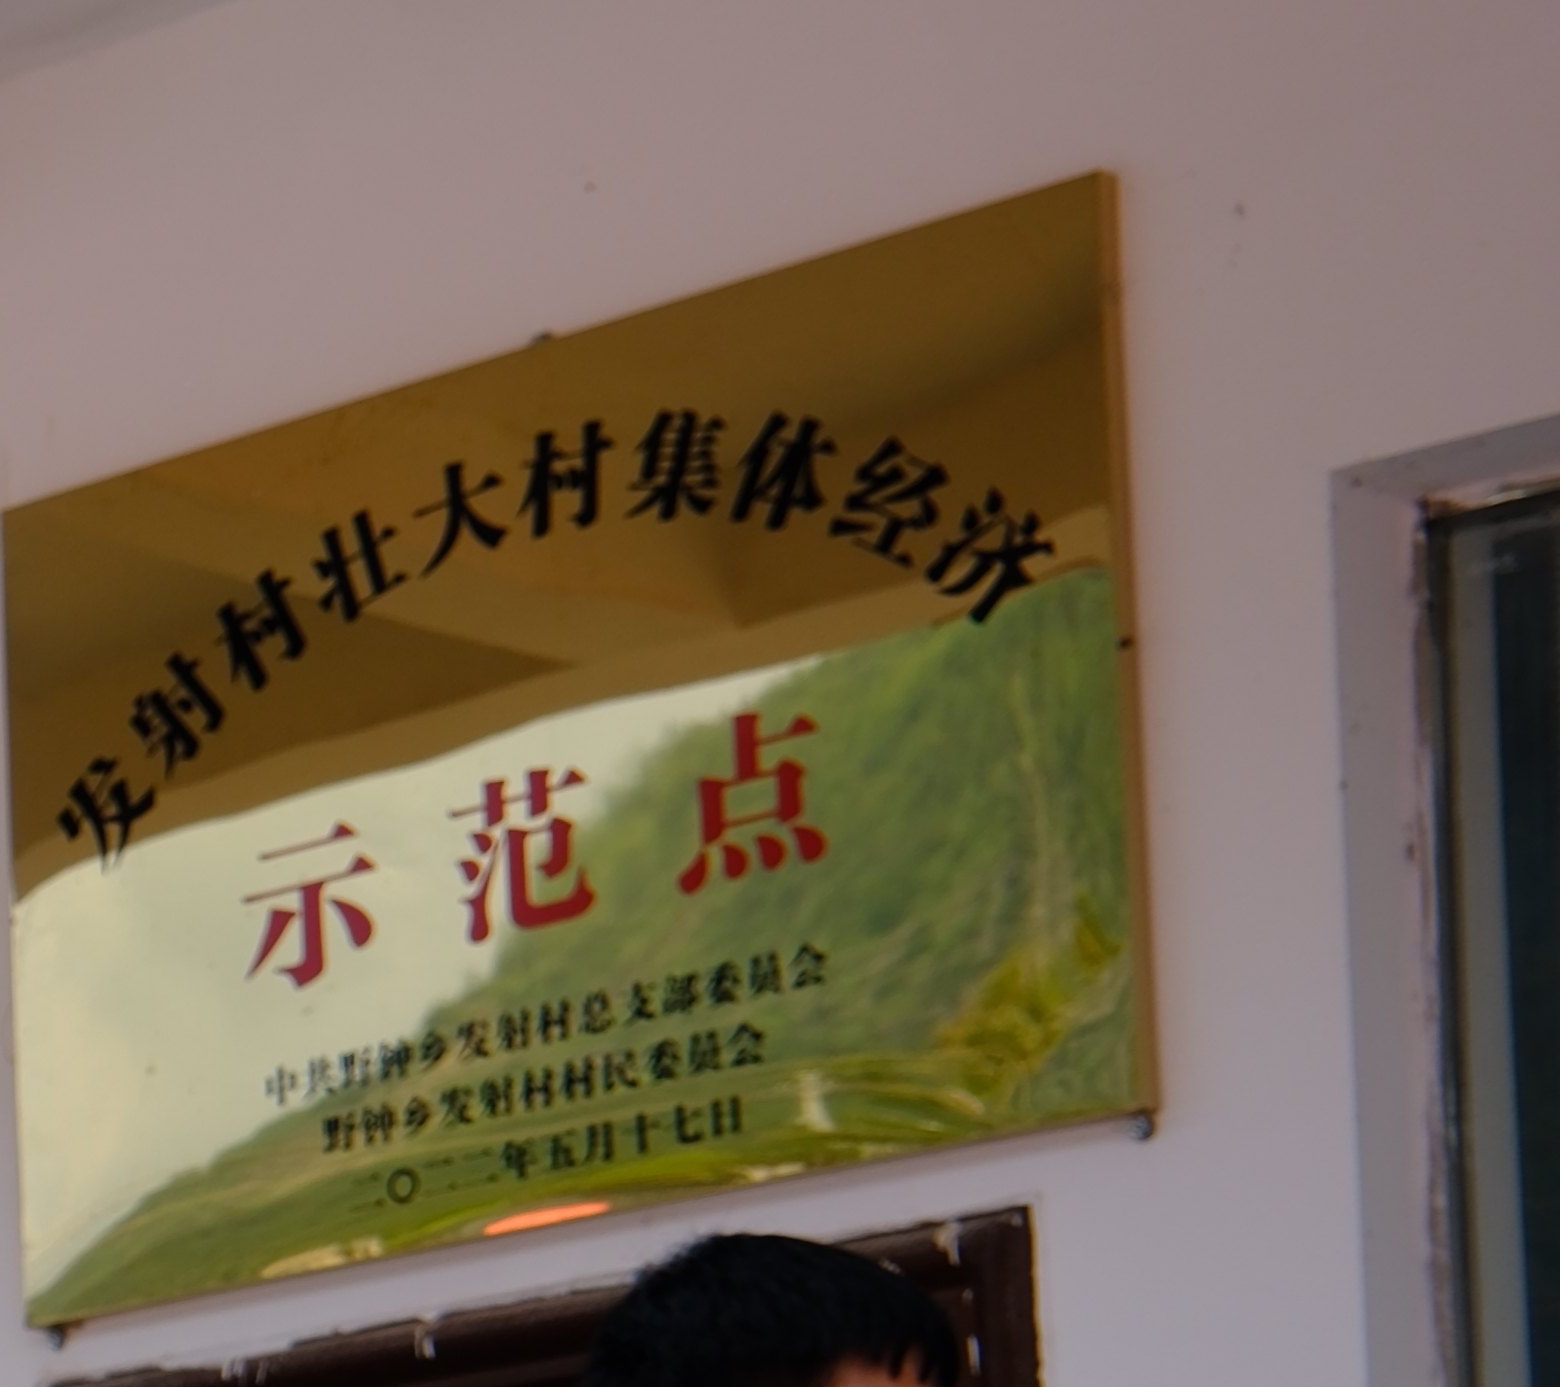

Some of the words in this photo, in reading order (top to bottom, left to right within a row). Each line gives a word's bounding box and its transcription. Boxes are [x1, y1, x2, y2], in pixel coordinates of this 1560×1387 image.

[55, 405, 1054, 874] 发射村壮大村集体经济
[243, 711, 828, 991] 示范点
[265, 943, 828, 1104] 中共野钟乡发射村总支部委员会
[322, 1021, 766, 1154] 野钟乡发射村村民委员会
